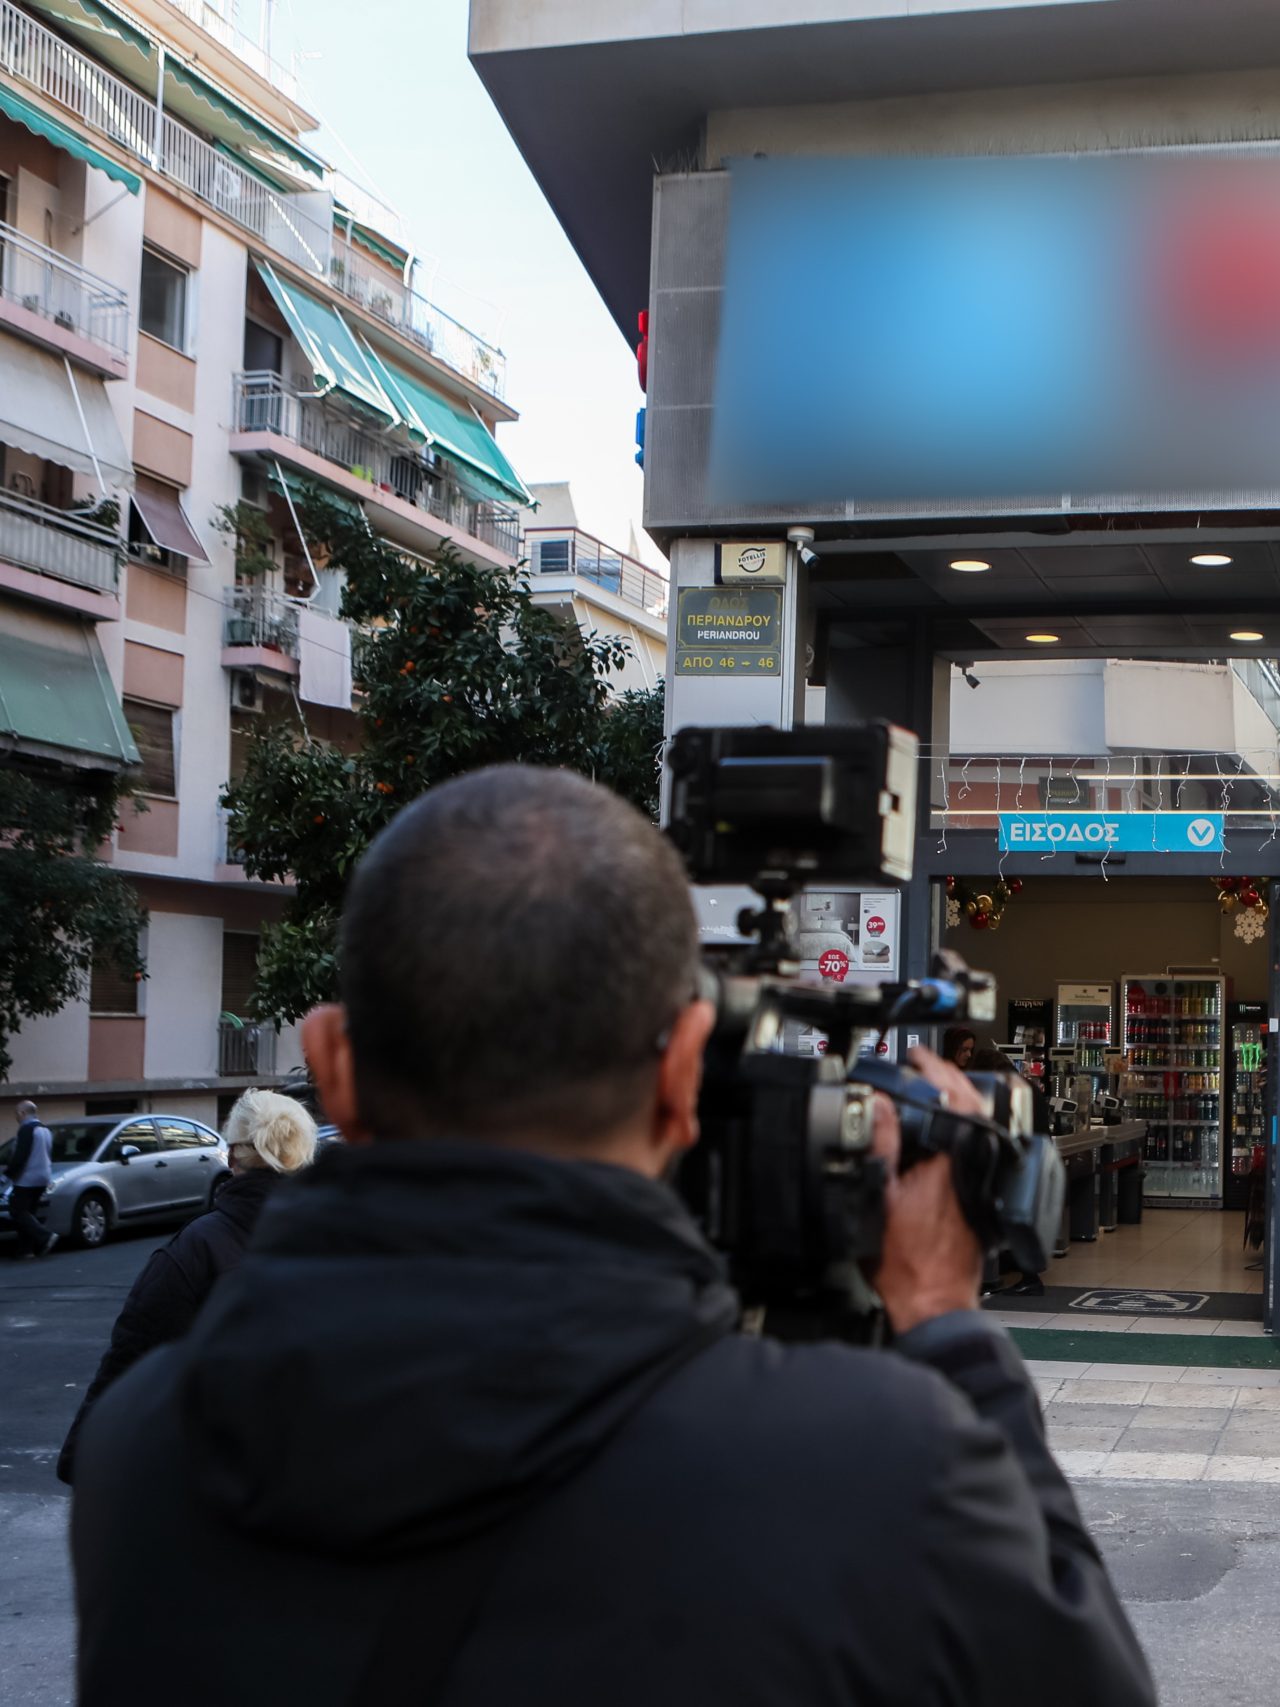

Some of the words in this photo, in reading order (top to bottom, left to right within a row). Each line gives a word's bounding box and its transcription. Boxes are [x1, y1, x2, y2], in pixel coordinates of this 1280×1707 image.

[687, 615, 771, 627] ΠΕΡΙΑΝΔΡΟΥ
[697, 630, 760, 640] PERIANDROU
[682, 657, 713, 668] ΑΠΟ
[719, 657, 735, 668] 46
[758, 657, 774, 668] 46
[1010, 823, 1120, 842] ΕΙΣΟΔΟΣ
